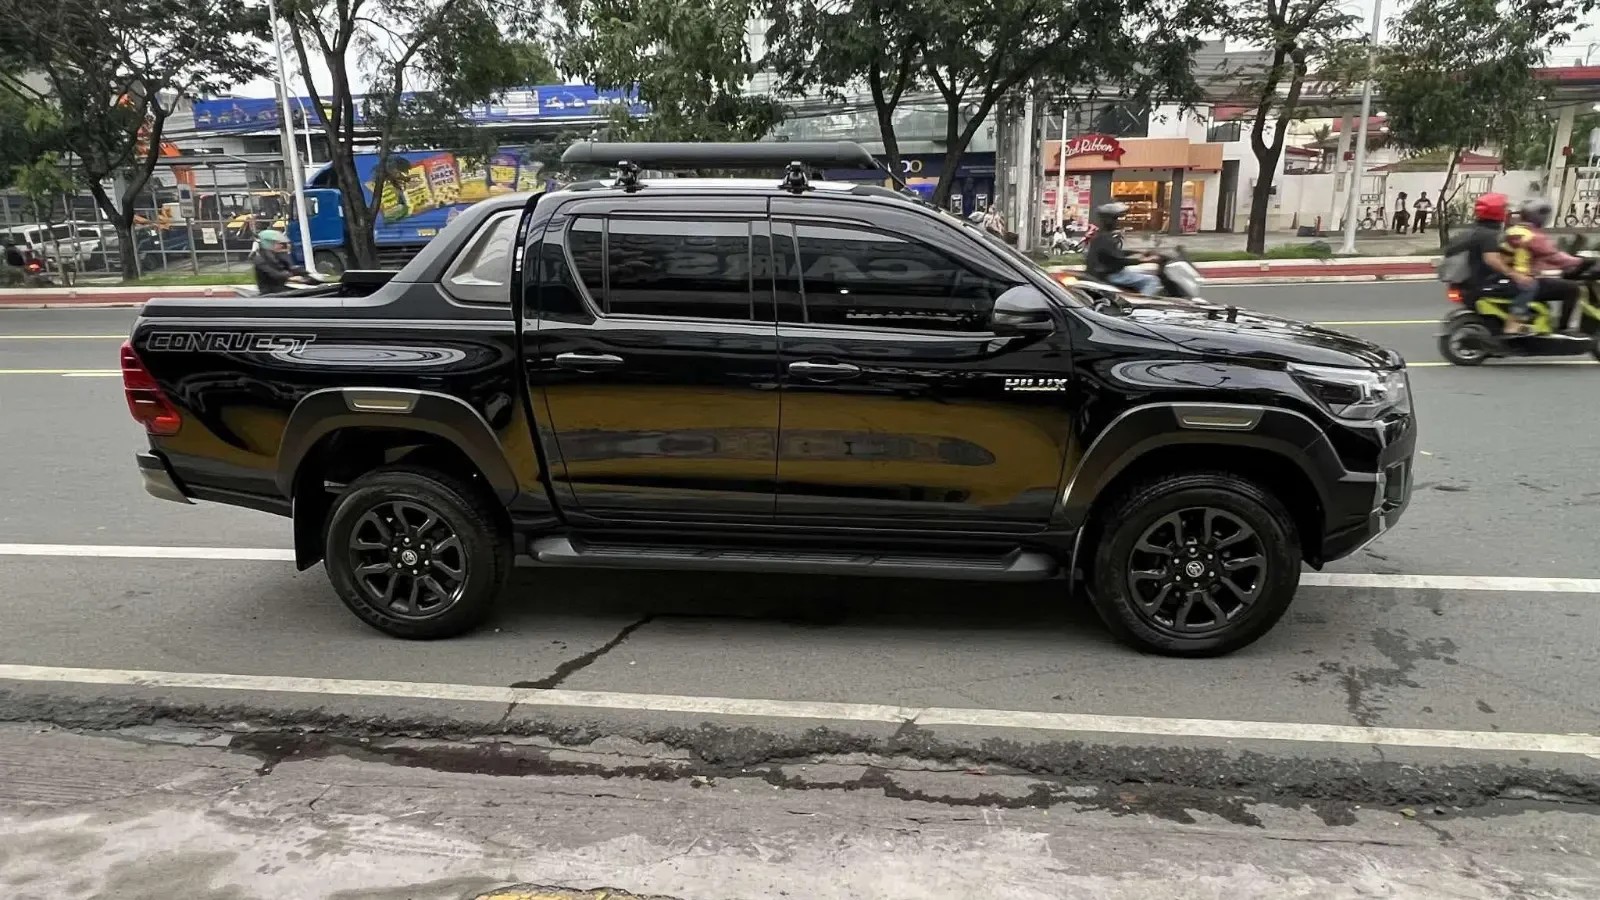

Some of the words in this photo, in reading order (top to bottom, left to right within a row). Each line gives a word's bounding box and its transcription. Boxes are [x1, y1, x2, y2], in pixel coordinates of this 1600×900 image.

[1080, 137, 1114, 153] Ribbon
[146, 331, 317, 353] CONQUEST
[1004, 378, 1068, 391] HILUX
